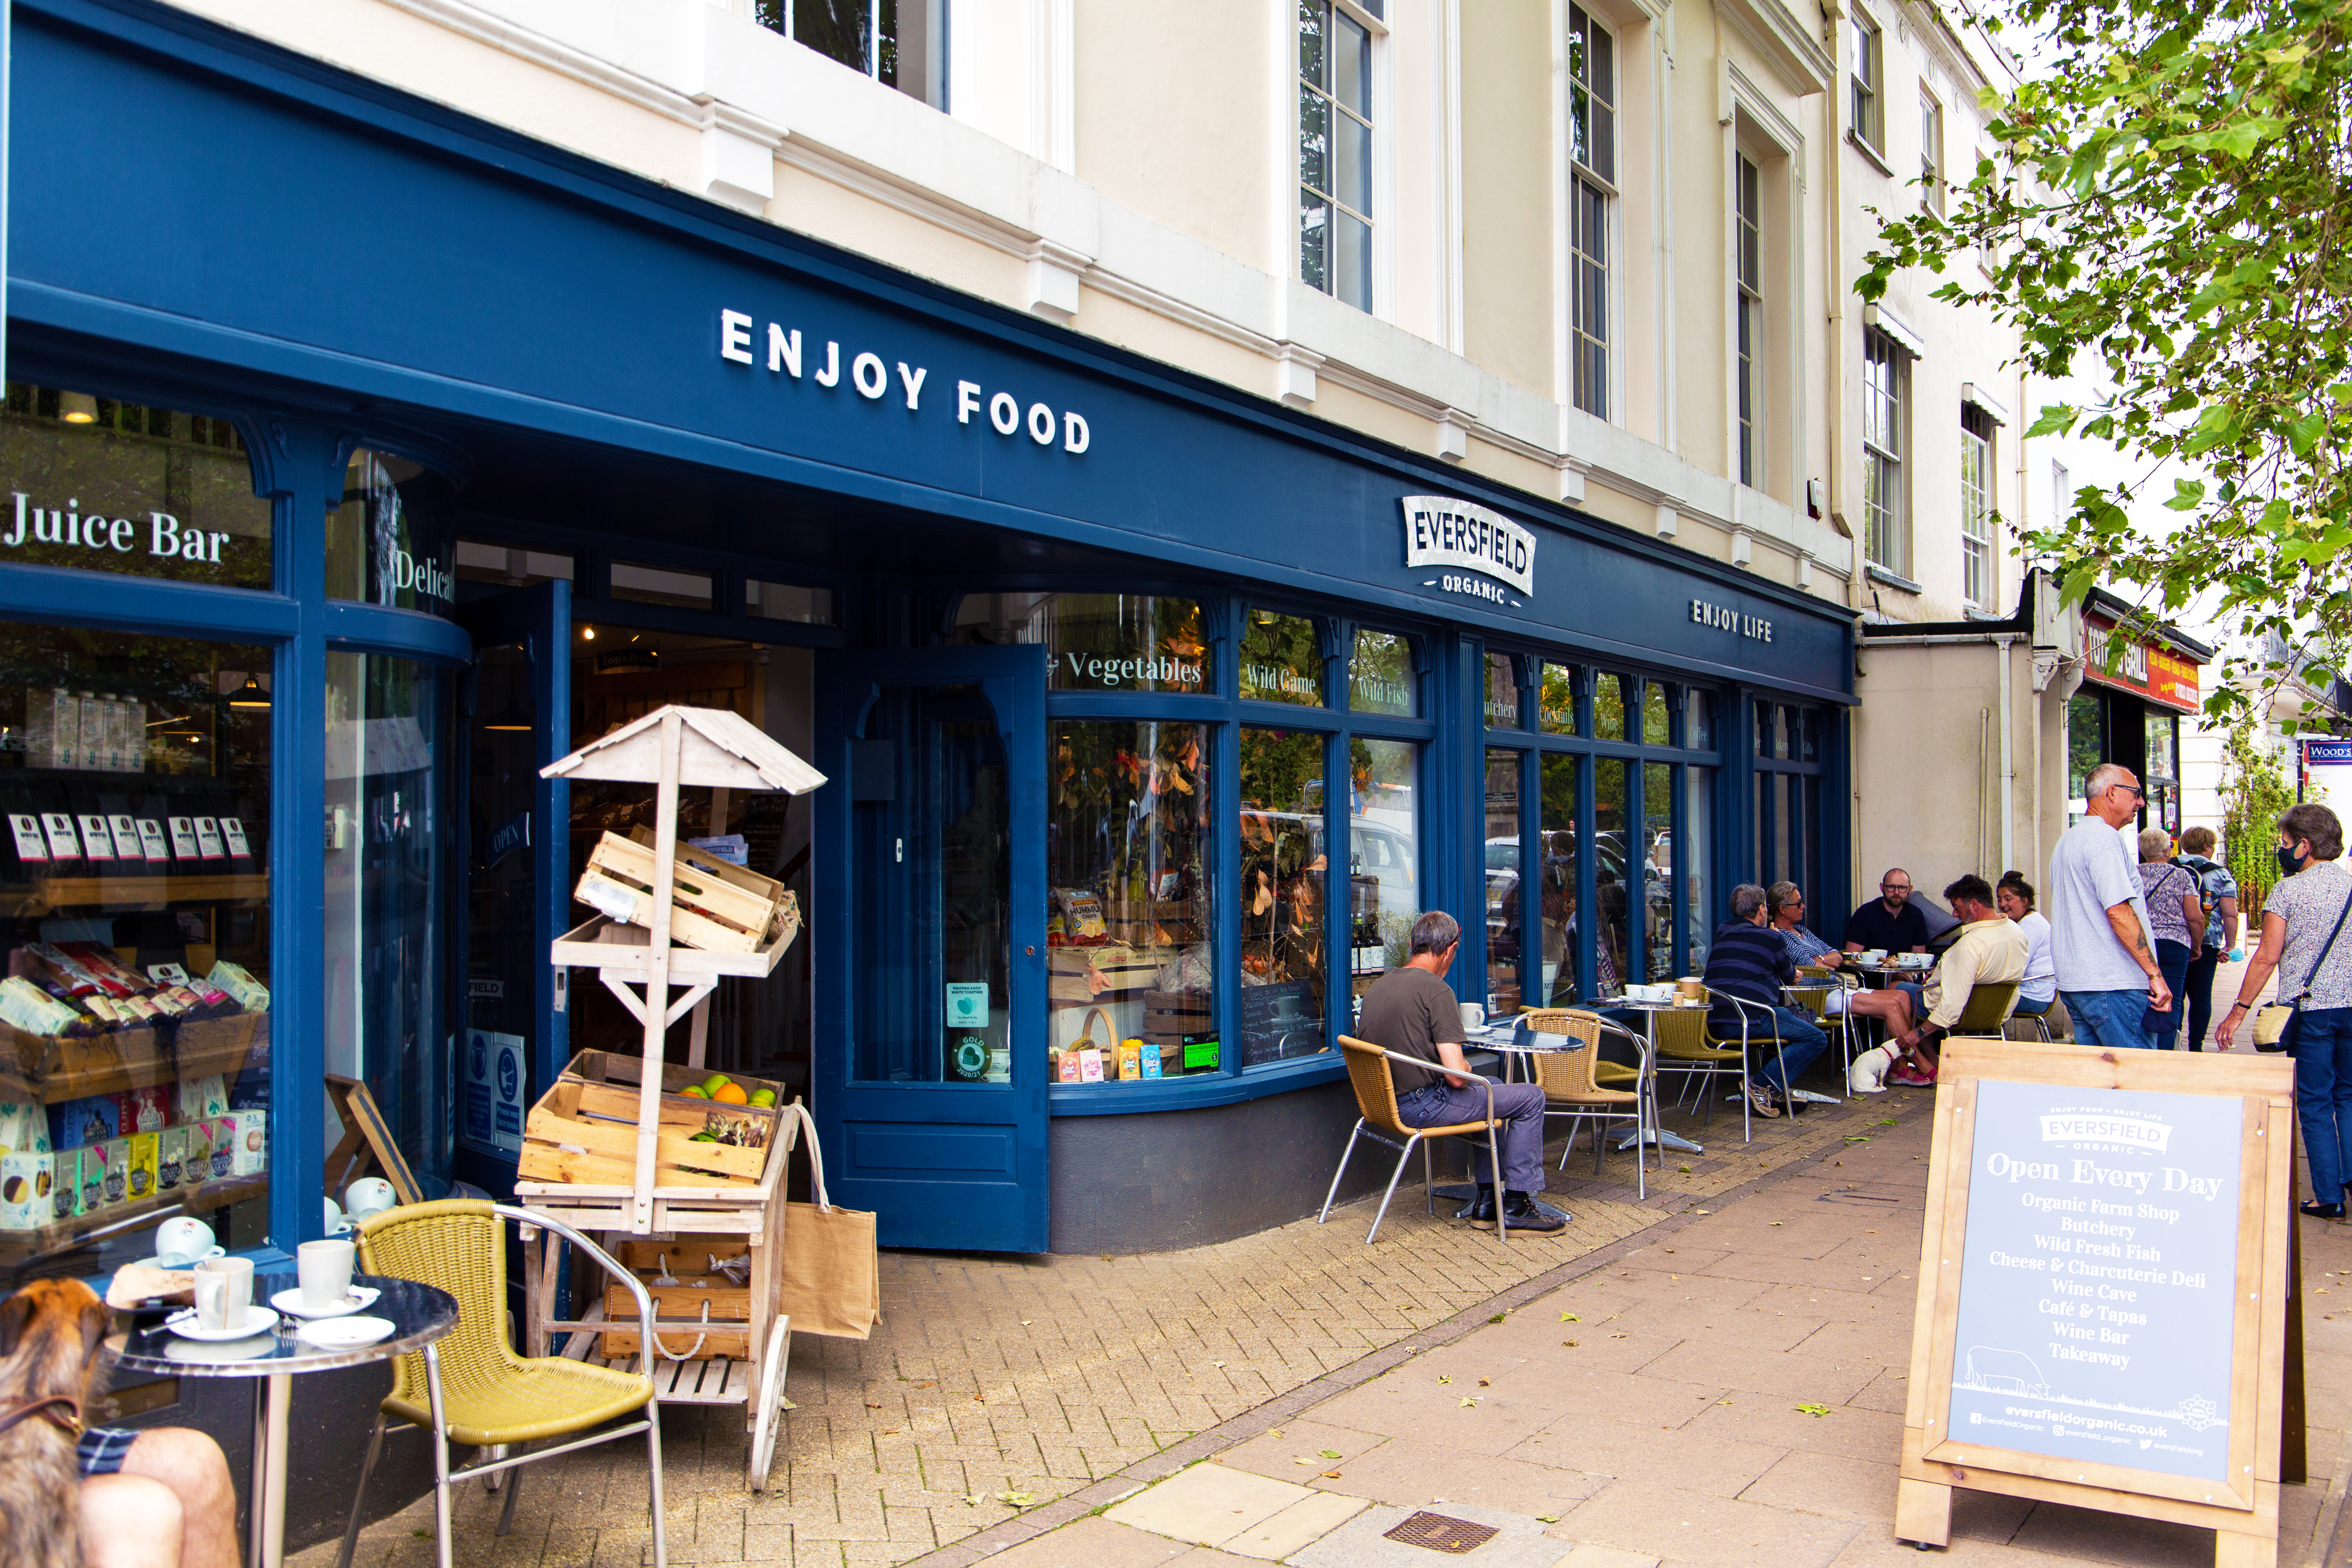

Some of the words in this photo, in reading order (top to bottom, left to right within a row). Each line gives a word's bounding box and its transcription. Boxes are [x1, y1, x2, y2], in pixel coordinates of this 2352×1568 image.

[721, 308, 927, 410] ENJOY
[958, 380, 1090, 454] FOOD
[4, 491, 134, 552] Juice
[150, 512, 230, 563] Bar
[1415, 512, 1527, 575] EVERSFIELD
[1443, 575, 1504, 604] ORGANIC
[1694, 599, 1738, 632] ENJOY
[1745, 615, 1771, 642] LIFE
[2087, 625, 2124, 673] TOT
[2125, 642, 2148, 682] GRILL
[1066, 653, 1201, 685] Vegetables
[1246, 664, 1276, 690] Wild
[1280, 669, 1316, 695] Game
[1359, 679, 1383, 702] Wild
[1387, 683, 1408, 705] Fish
[1484, 699, 1517, 724] utchery
[1539, 704, 1574, 724] Cocktails
[1601, 713, 1618, 731] Wine
[1648, 719, 1665, 741] Dairy
[1689, 726, 1707, 742] Coffee
[1802, 741, 1813, 755] Gifts
[495, 823, 518, 852] OPEN
[469, 982, 499, 993] FIELD
[963, 1037, 984, 1046] GOLD
[957, 1067, 981, 1077] 2020/21
[497, 1105, 510, 1116] Please
[510, 1111, 519, 1119] wear
[498, 1117, 506, 1127] face
[506, 1121, 519, 1131] masks
[2114, 1109, 2141, 1117] ENJOY
[2049, 1121, 2160, 1142] EVERSFIELD
[2073, 1143, 2134, 1155] ORGANIC
[1987, 1152, 2060, 1183] Open
[2070, 1159, 2153, 1195] Every
[2161, 1167, 2223, 1201] Day
[2022, 1192, 2086, 1213] Organic
[2090, 1199, 2133, 1217] Farm
[2138, 1203, 2180, 1224] Shop
[2061, 1217, 2136, 1241] Butchery
[2034, 1235, 2071, 1252] Wild
[2075, 1240, 2121, 1258] Fresh
[2126, 1245, 2161, 1262] Fish
[1990, 1251, 2046, 1271] Cheese
[2050, 1258, 2064, 1272] &
[2068, 1260, 2167, 1284] Charcuterie
[2171, 1271, 2206, 1289] Deli
[2051, 1278, 2094, 1297] Wine
[2097, 1284, 2137, 1302] Cave
[2039, 1299, 2075, 1316] Café
[2079, 1303, 2094, 1318] &
[2097, 1306, 2147, 1326] Tapas
[2053, 1321, 2095, 1340] Wine
[2100, 1327, 2130, 1346] Bar
[2049, 1343, 2131, 1371] Takeaway
[1982, 1416, 2044, 1432] EversfieldOrganic
[2005, 1405, 2167, 1438] eversfieldorganic.co.uk
[2065, 1428, 2132, 1445] eversfield_organic
[2153, 1442, 2204, 1457] eversfieldorg
